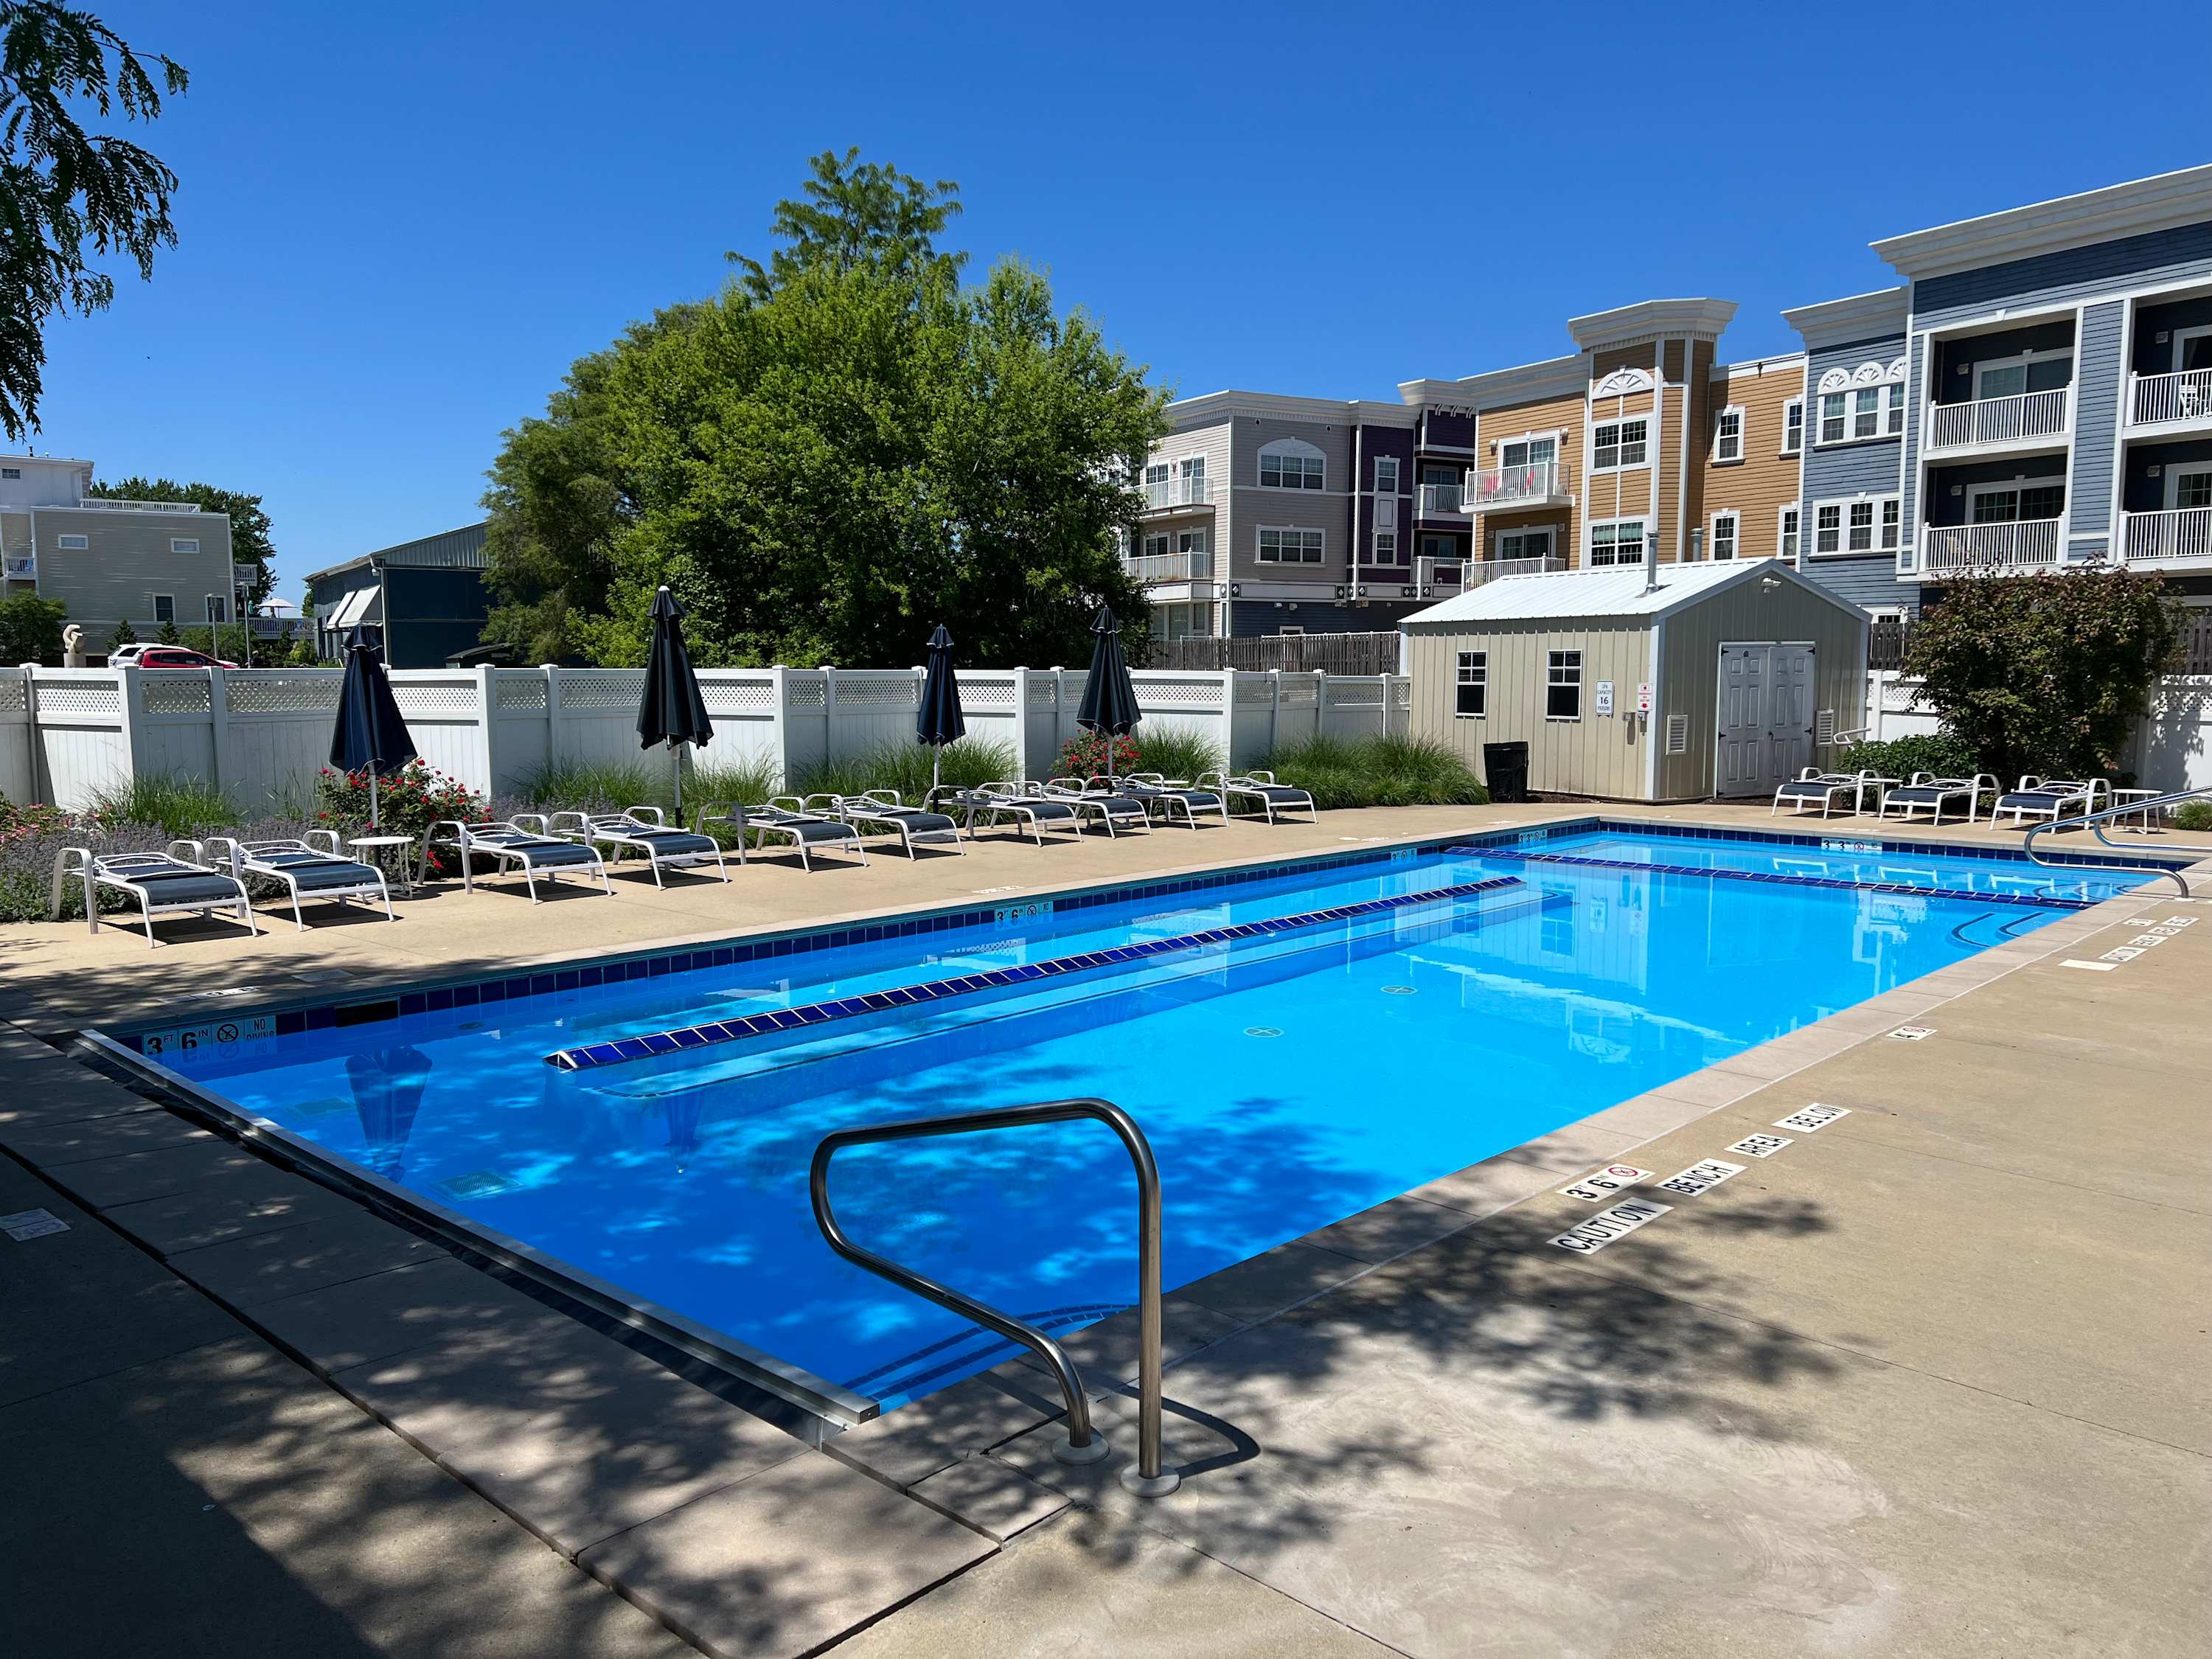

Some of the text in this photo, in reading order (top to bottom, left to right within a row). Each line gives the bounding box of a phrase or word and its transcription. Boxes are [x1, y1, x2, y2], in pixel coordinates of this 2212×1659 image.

[1823, 840, 1830, 848] 3
[997, 911, 1004, 920] 3
[1012, 909, 1018, 919] 6
[254, 1018, 266, 1031] NO
[147, 1029, 209, 1055] 3 FT 6 IN
[1557, 1104, 1845, 1250] CAUTION BENCH AREA BELOW
[1566, 1189, 1598, 1199] 3
[1587, 1179, 1620, 1189] 6
